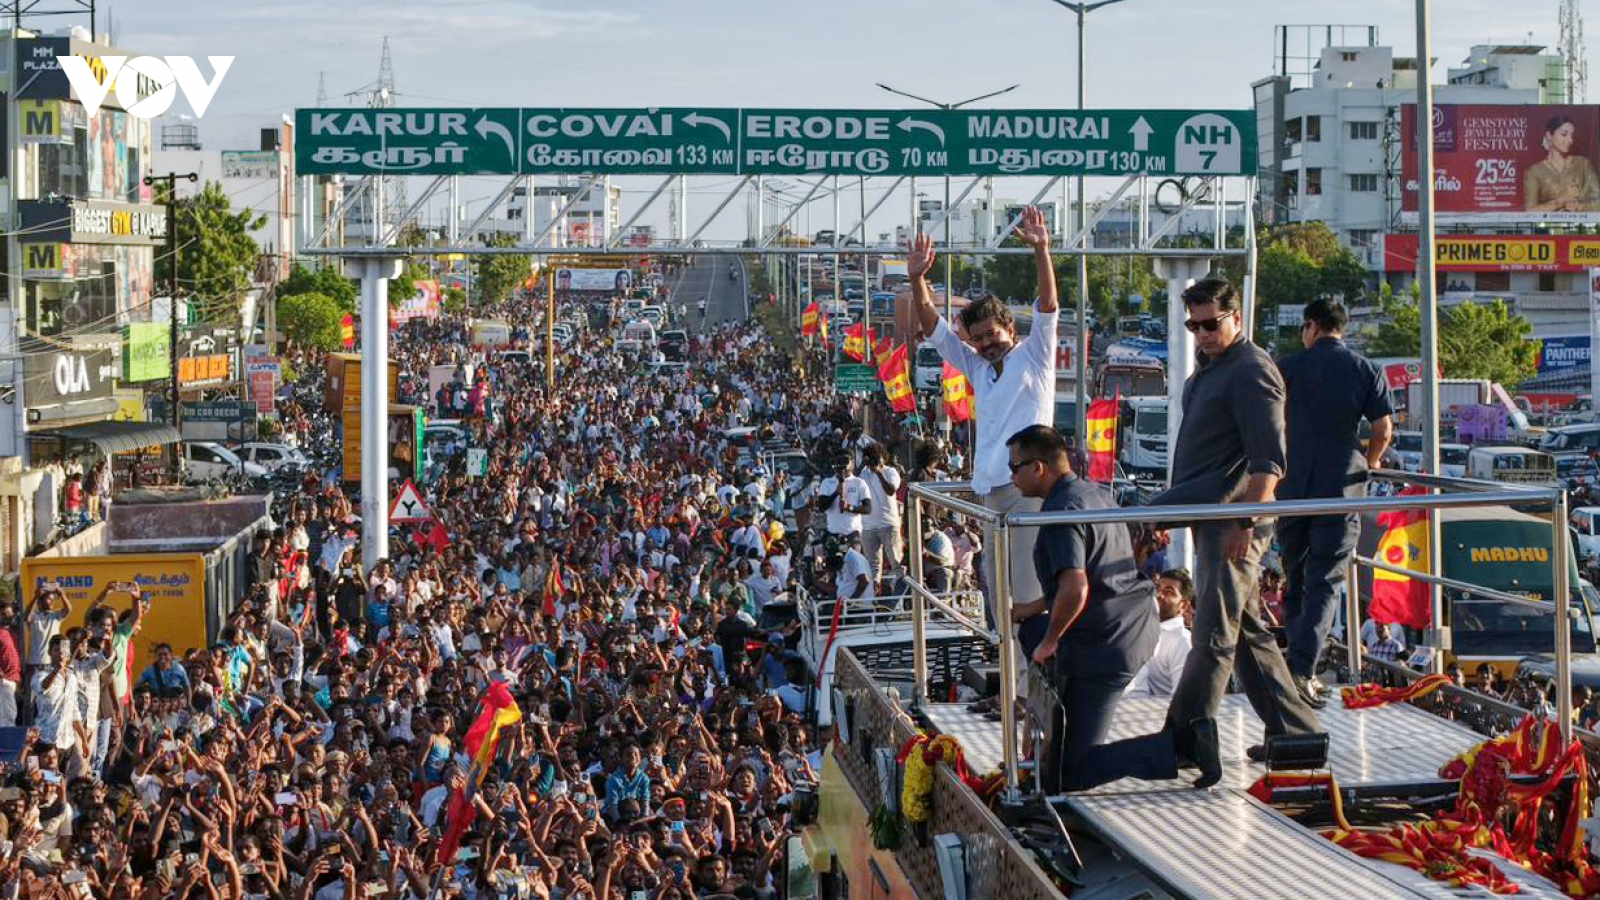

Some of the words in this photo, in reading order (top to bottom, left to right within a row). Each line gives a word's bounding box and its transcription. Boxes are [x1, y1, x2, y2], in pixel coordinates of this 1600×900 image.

[33, 47, 54, 58] MM
[23, 61, 62, 71] PLAZA
[26, 111, 52, 136] M
[310, 112, 470, 137] KARUR
[526, 113, 674, 139] COVAI
[746, 115, 891, 140] ERODE
[967, 115, 1111, 140] MADURAI
[1463, 117, 1528, 128] GEMSTONE
[1464, 129, 1526, 139] JEWELLERY
[1184, 124, 1232, 146] NH
[1464, 139, 1528, 151] FESTIVAL
[526, 143, 673, 166] கோவை
[676, 144, 707, 165] 133
[712, 150, 734, 165] KM
[901, 147, 923, 168] 70
[927, 151, 948, 167] KM
[968, 148, 1109, 172] மதுரை
[1110, 150, 1141, 171] 130
[1145, 155, 1166, 171] KM
[1199, 150, 1214, 170] 7
[1475, 158, 1516, 184] 25%
[74, 207, 111, 234] BIGGEST
[112, 209, 132, 236] GYM
[29, 244, 55, 269] M
[55, 354, 91, 396] OLA
[1470, 546, 1549, 563] MADHU
